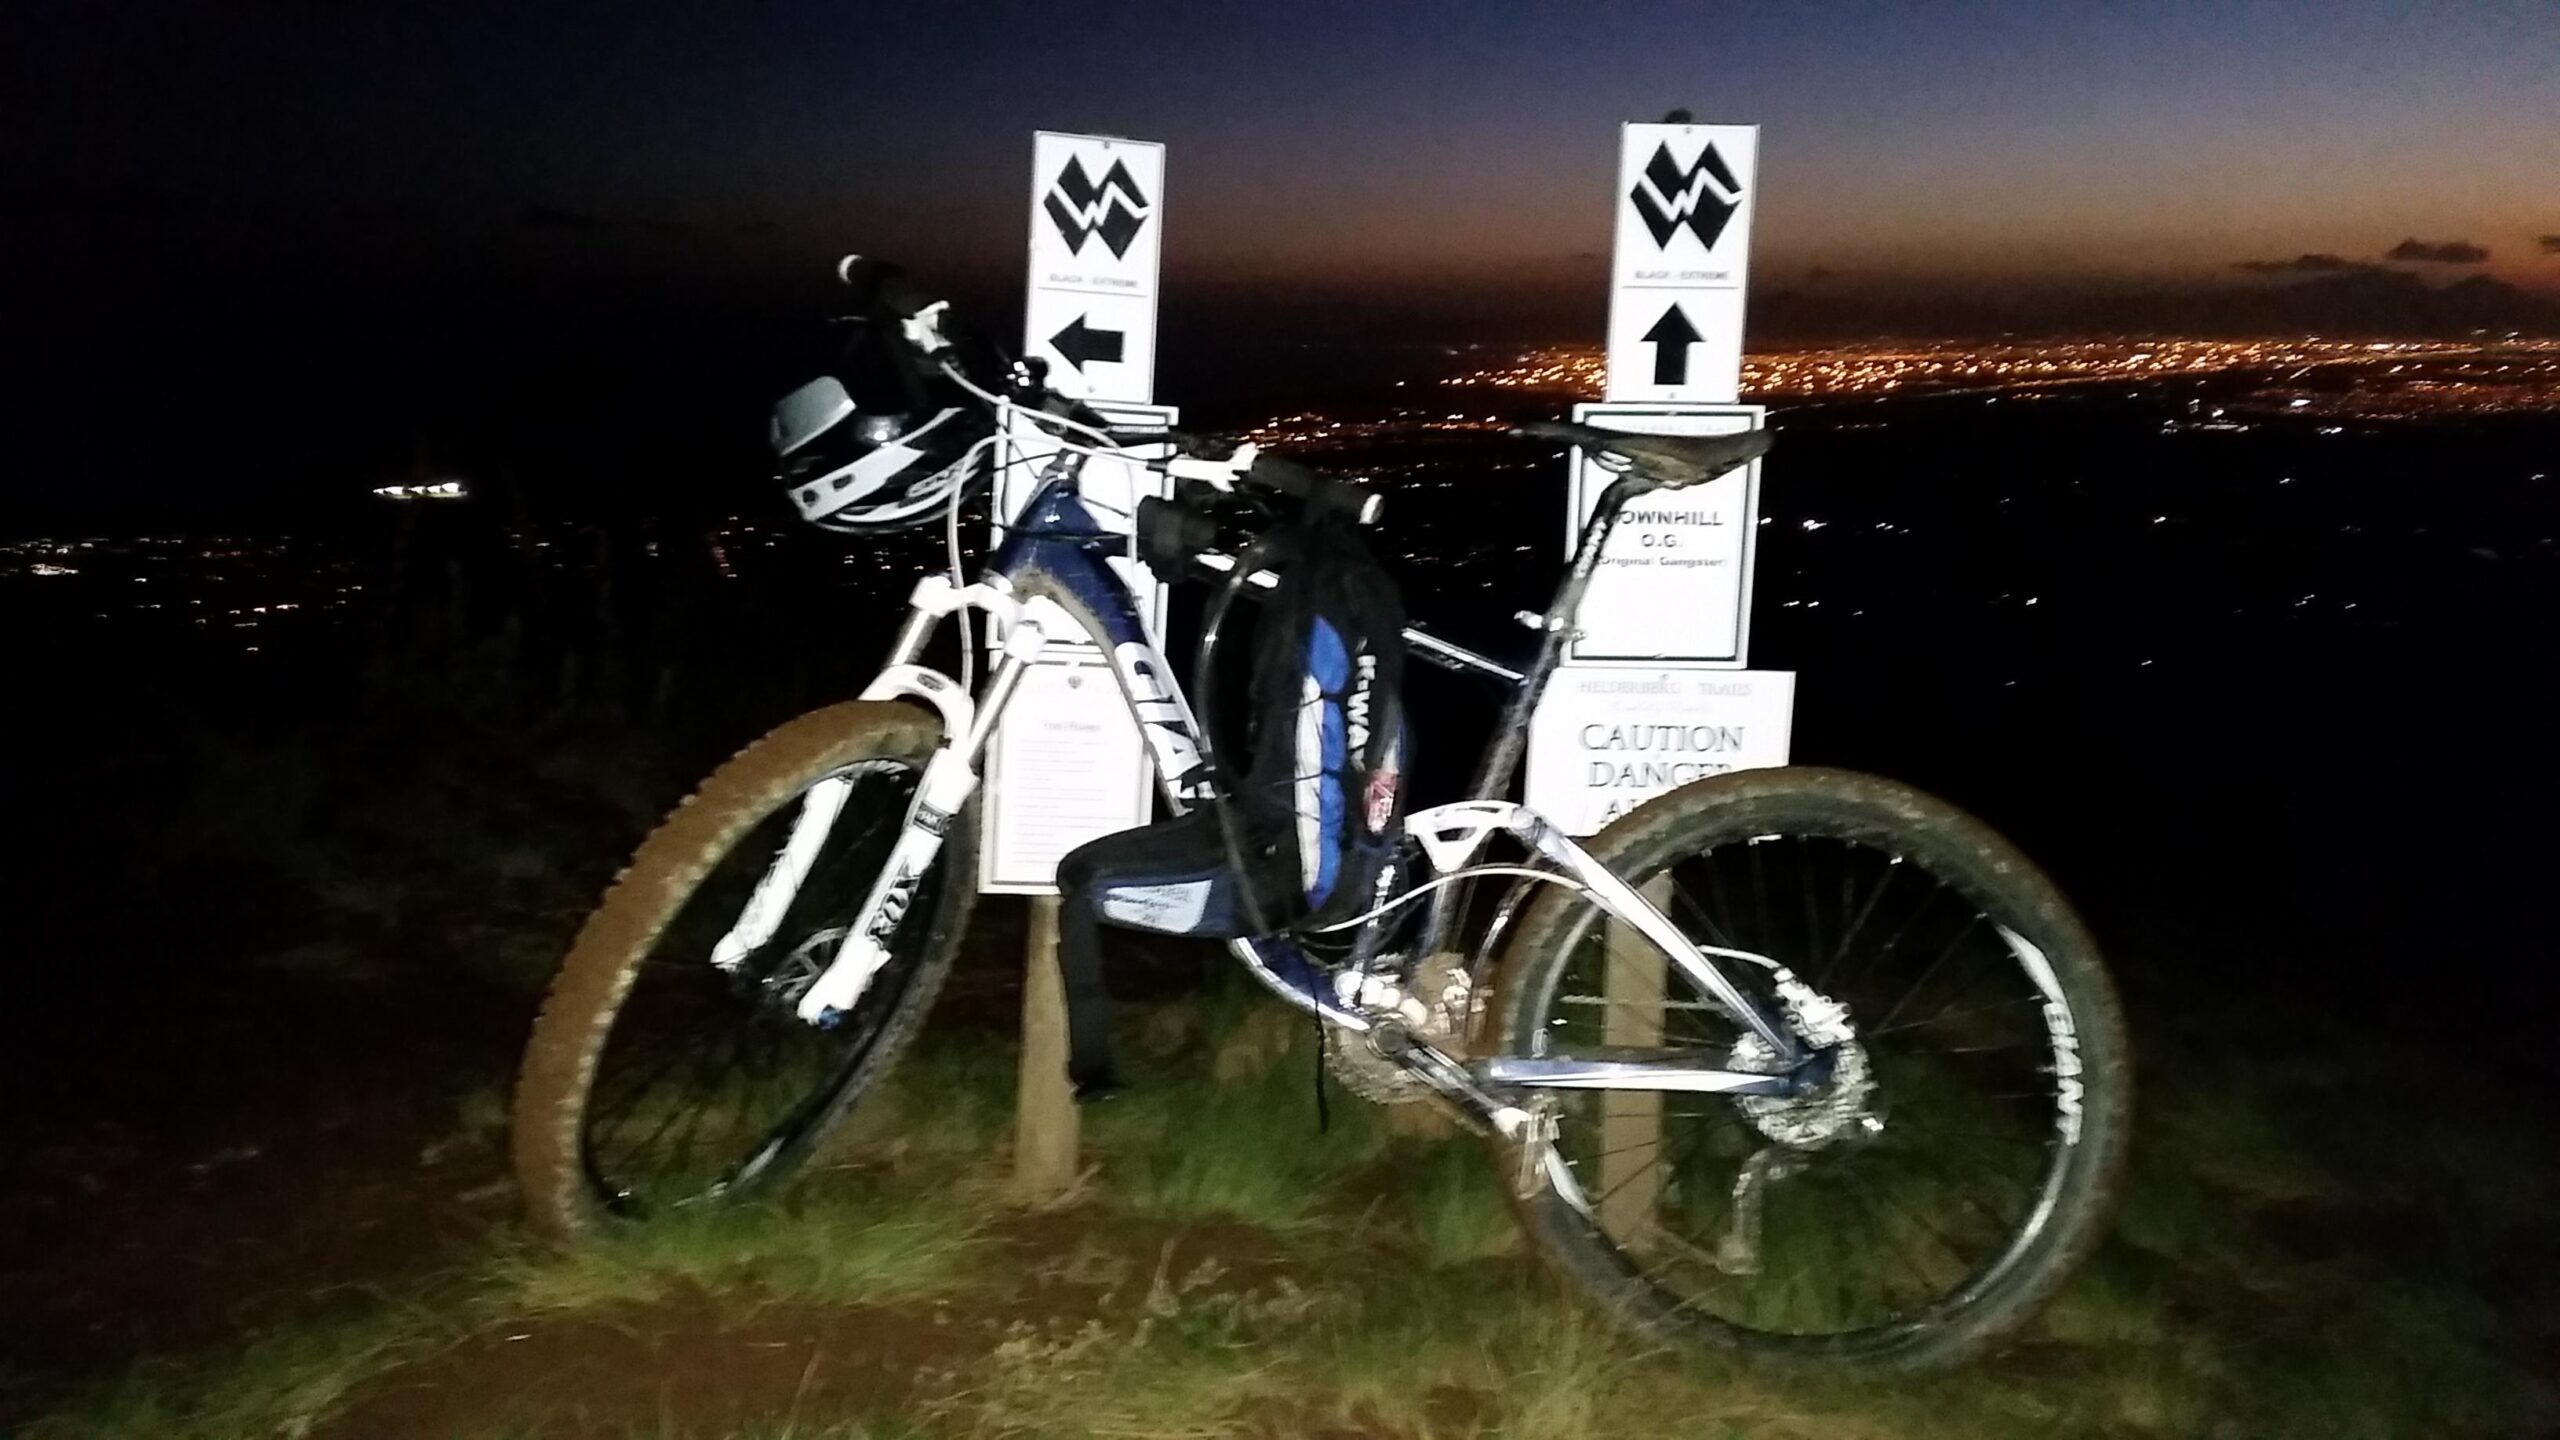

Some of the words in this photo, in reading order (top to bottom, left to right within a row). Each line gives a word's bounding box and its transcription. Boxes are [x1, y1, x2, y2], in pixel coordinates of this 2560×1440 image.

[1618, 510, 1724, 527] OWNHILL
[1578, 723, 1746, 752] CAUTION
[2042, 1001, 2085, 1147] GIANT
